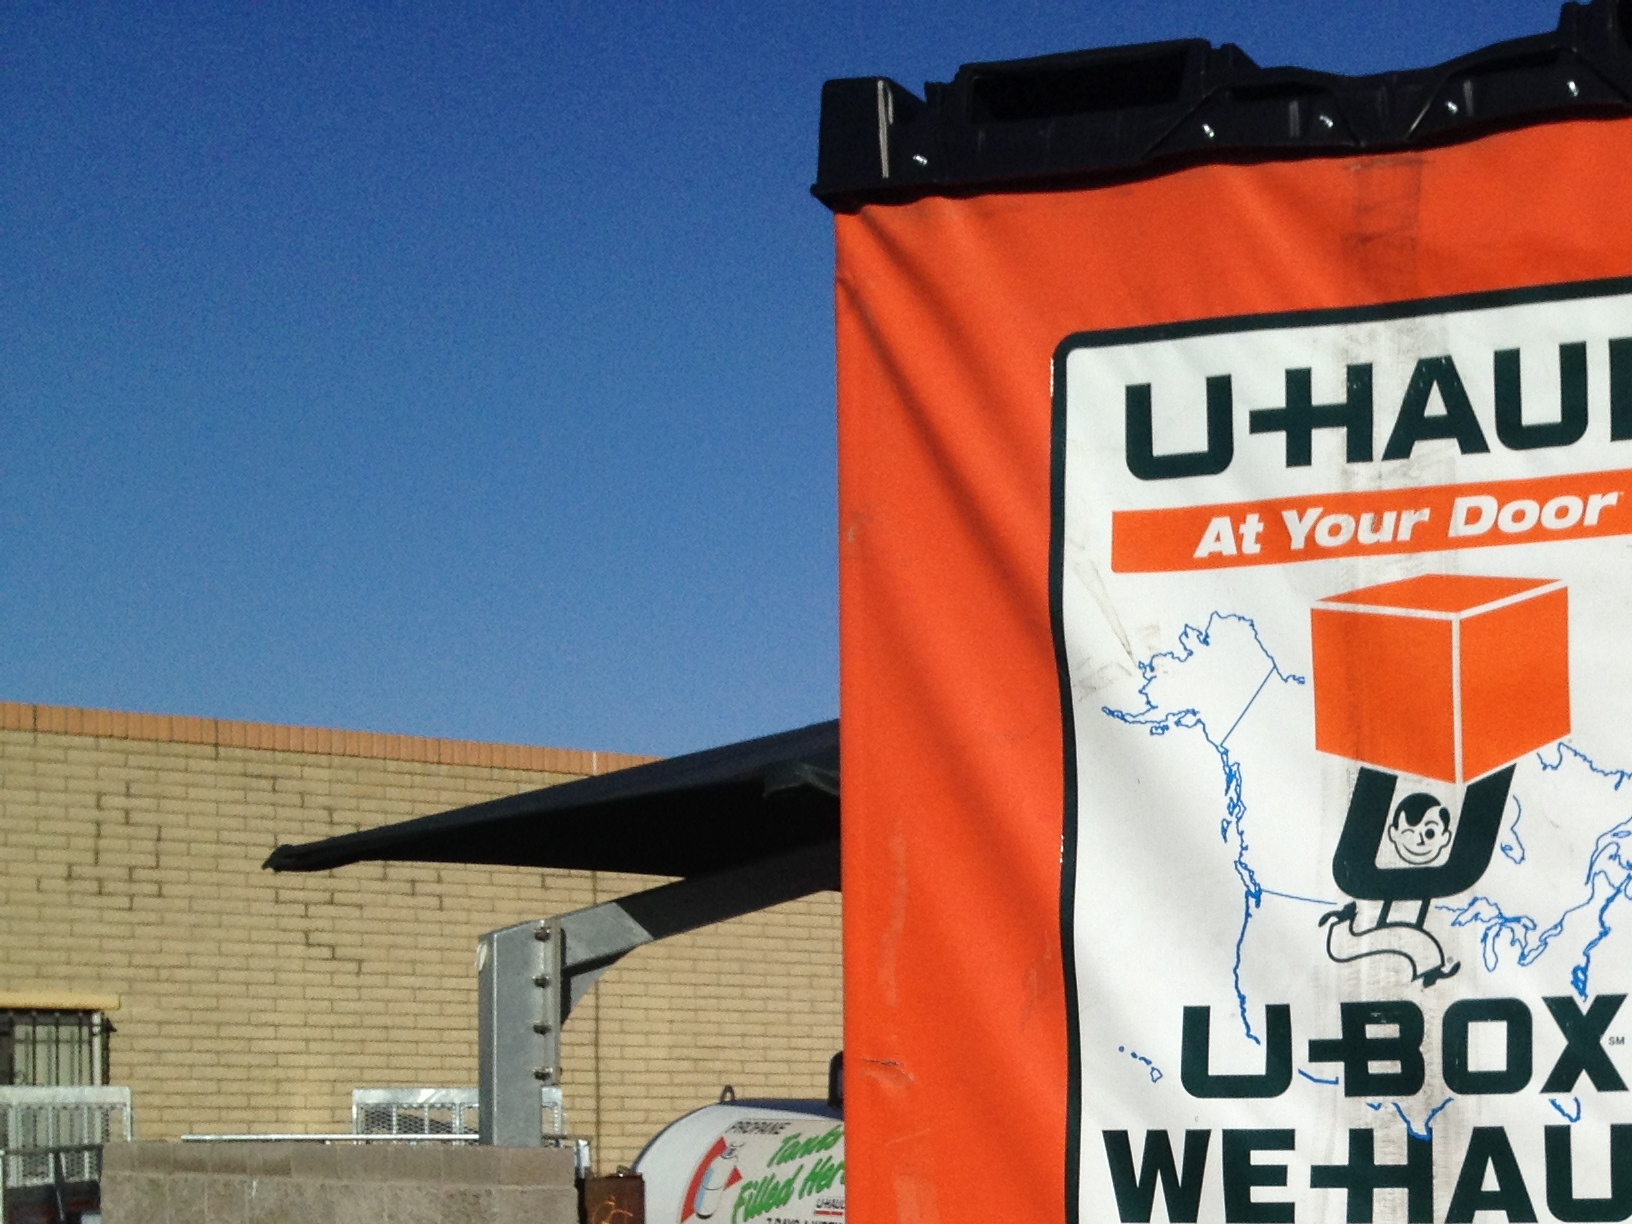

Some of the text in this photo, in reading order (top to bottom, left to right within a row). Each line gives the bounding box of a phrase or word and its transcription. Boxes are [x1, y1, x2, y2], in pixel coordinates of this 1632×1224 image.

[1194, 488, 1618, 559] At Your Door
[1179, 993, 1629, 1099] U-BOX
